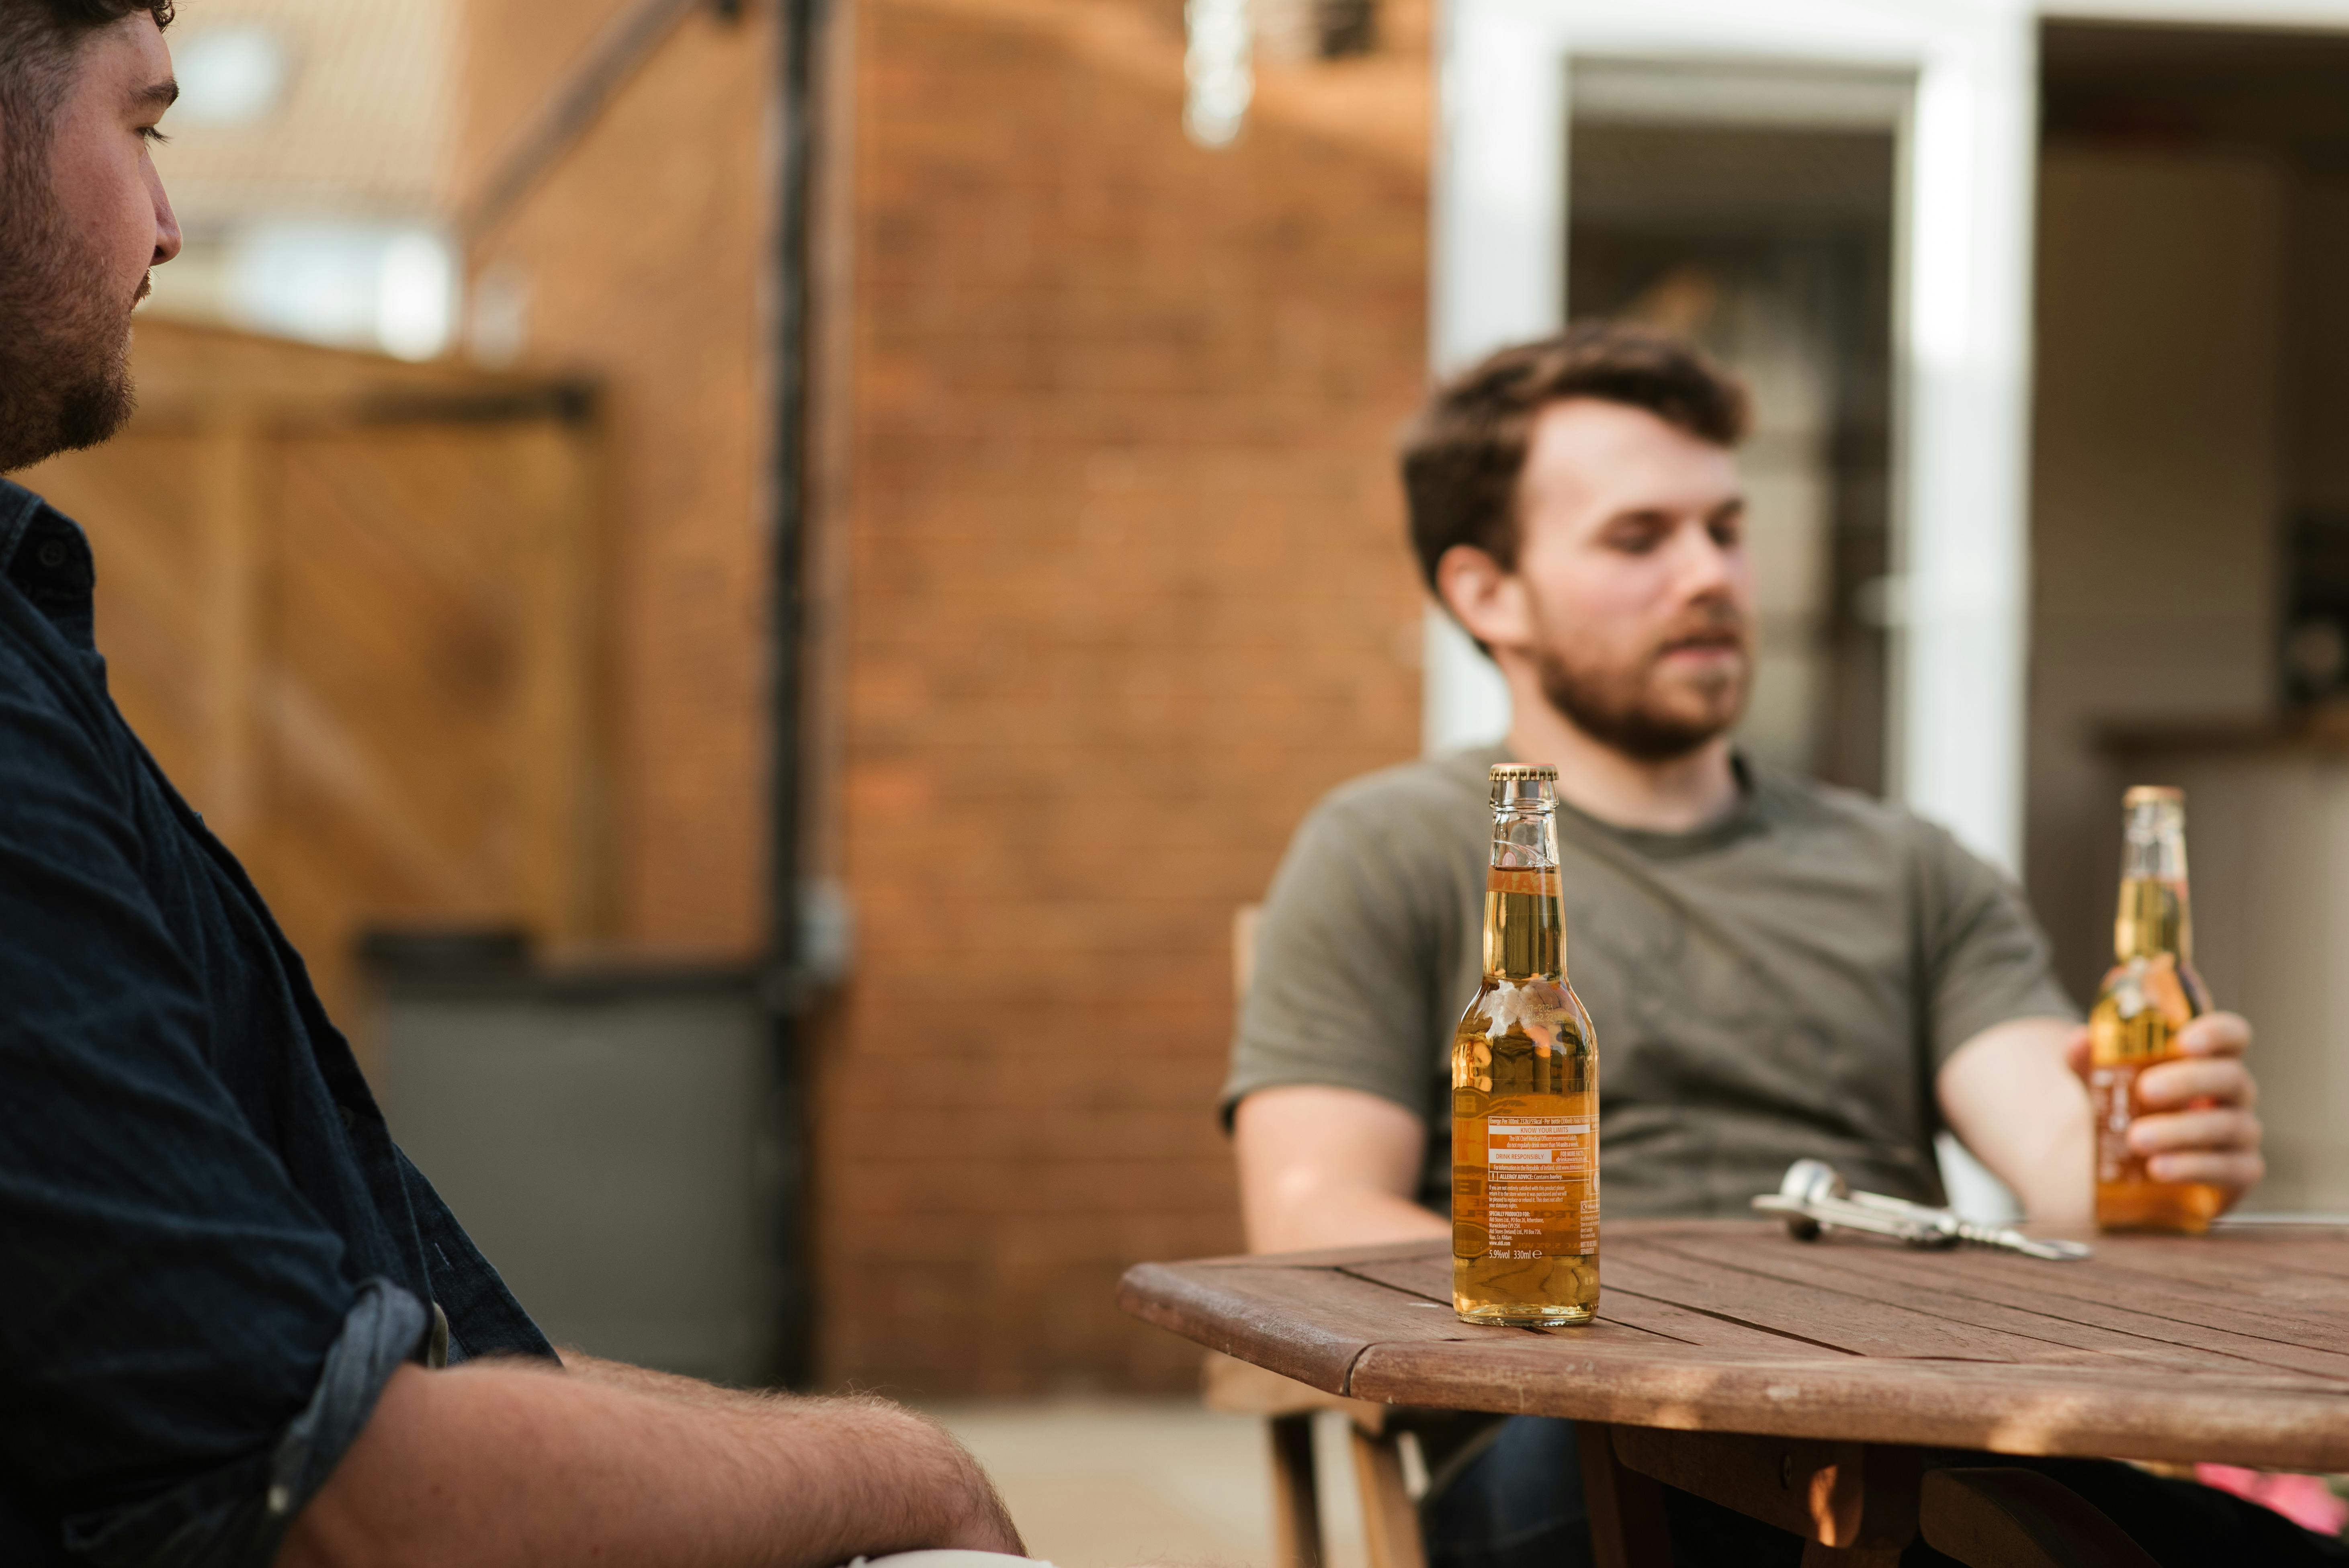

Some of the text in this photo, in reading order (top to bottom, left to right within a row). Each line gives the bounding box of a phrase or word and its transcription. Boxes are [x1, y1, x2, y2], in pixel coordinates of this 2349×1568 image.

[1526, 1004, 1554, 1013] 07-2021
[1489, 1249, 1509, 1259] 5.9%vol
[1513, 1250, 1531, 1259] 330ml
